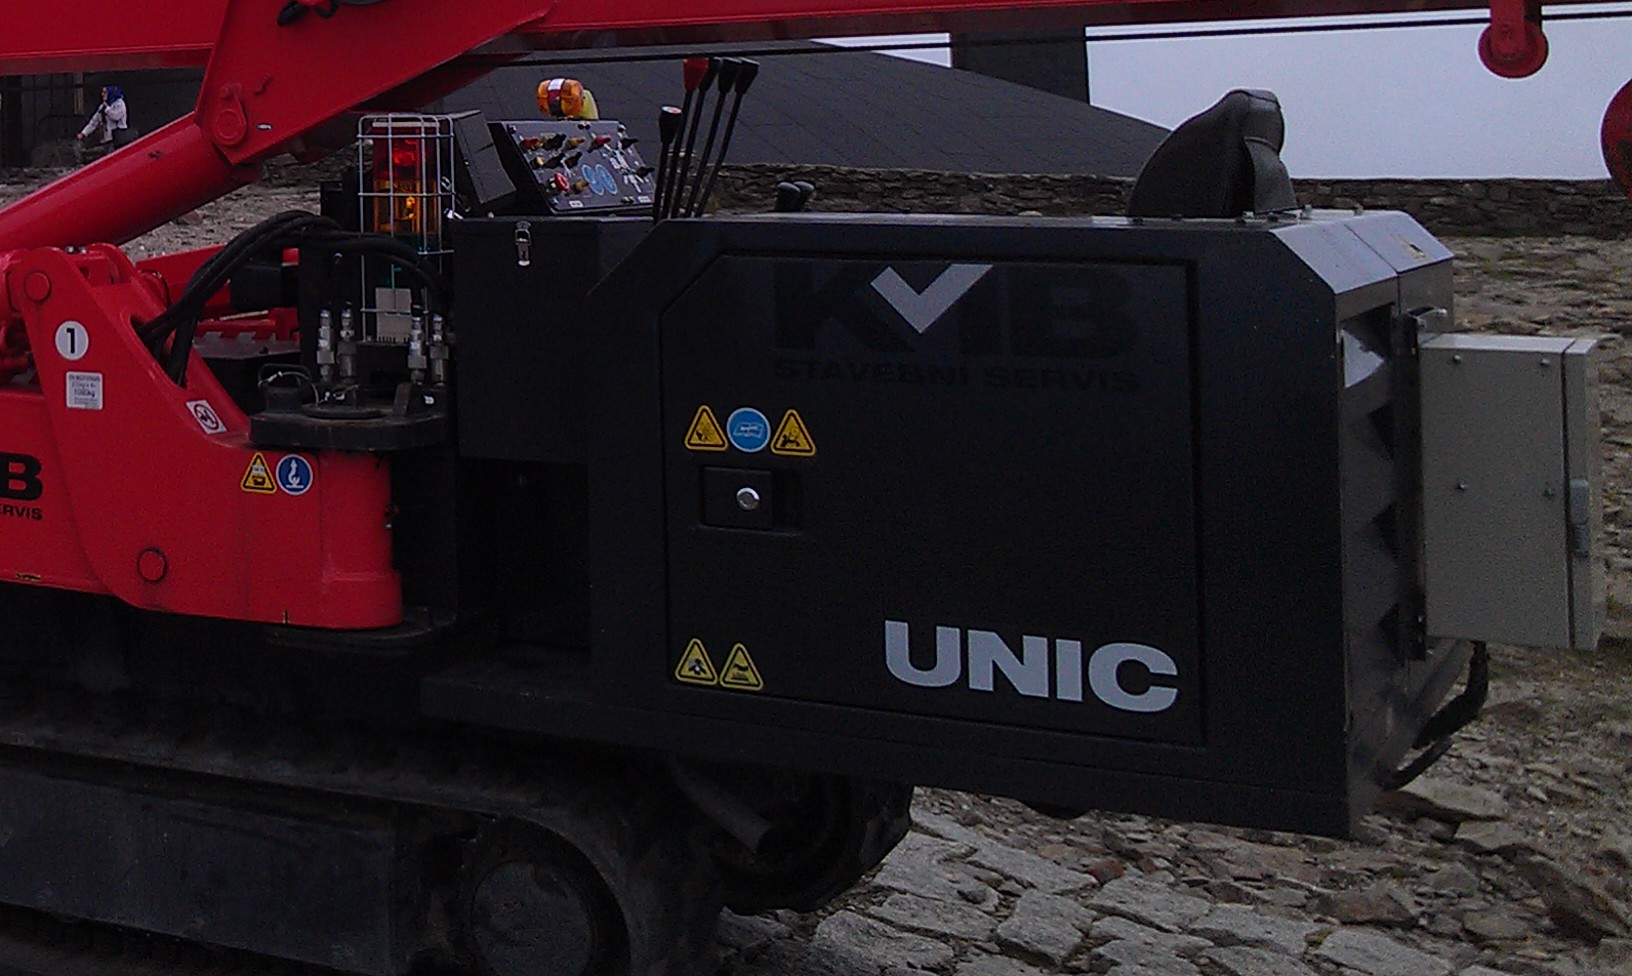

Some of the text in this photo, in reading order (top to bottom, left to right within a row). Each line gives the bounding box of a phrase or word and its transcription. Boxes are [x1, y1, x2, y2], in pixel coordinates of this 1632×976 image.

[66, 327, 76, 354] 1
[983, 365, 1141, 394] SERVIS
[884, 619, 1179, 713] UNIC
